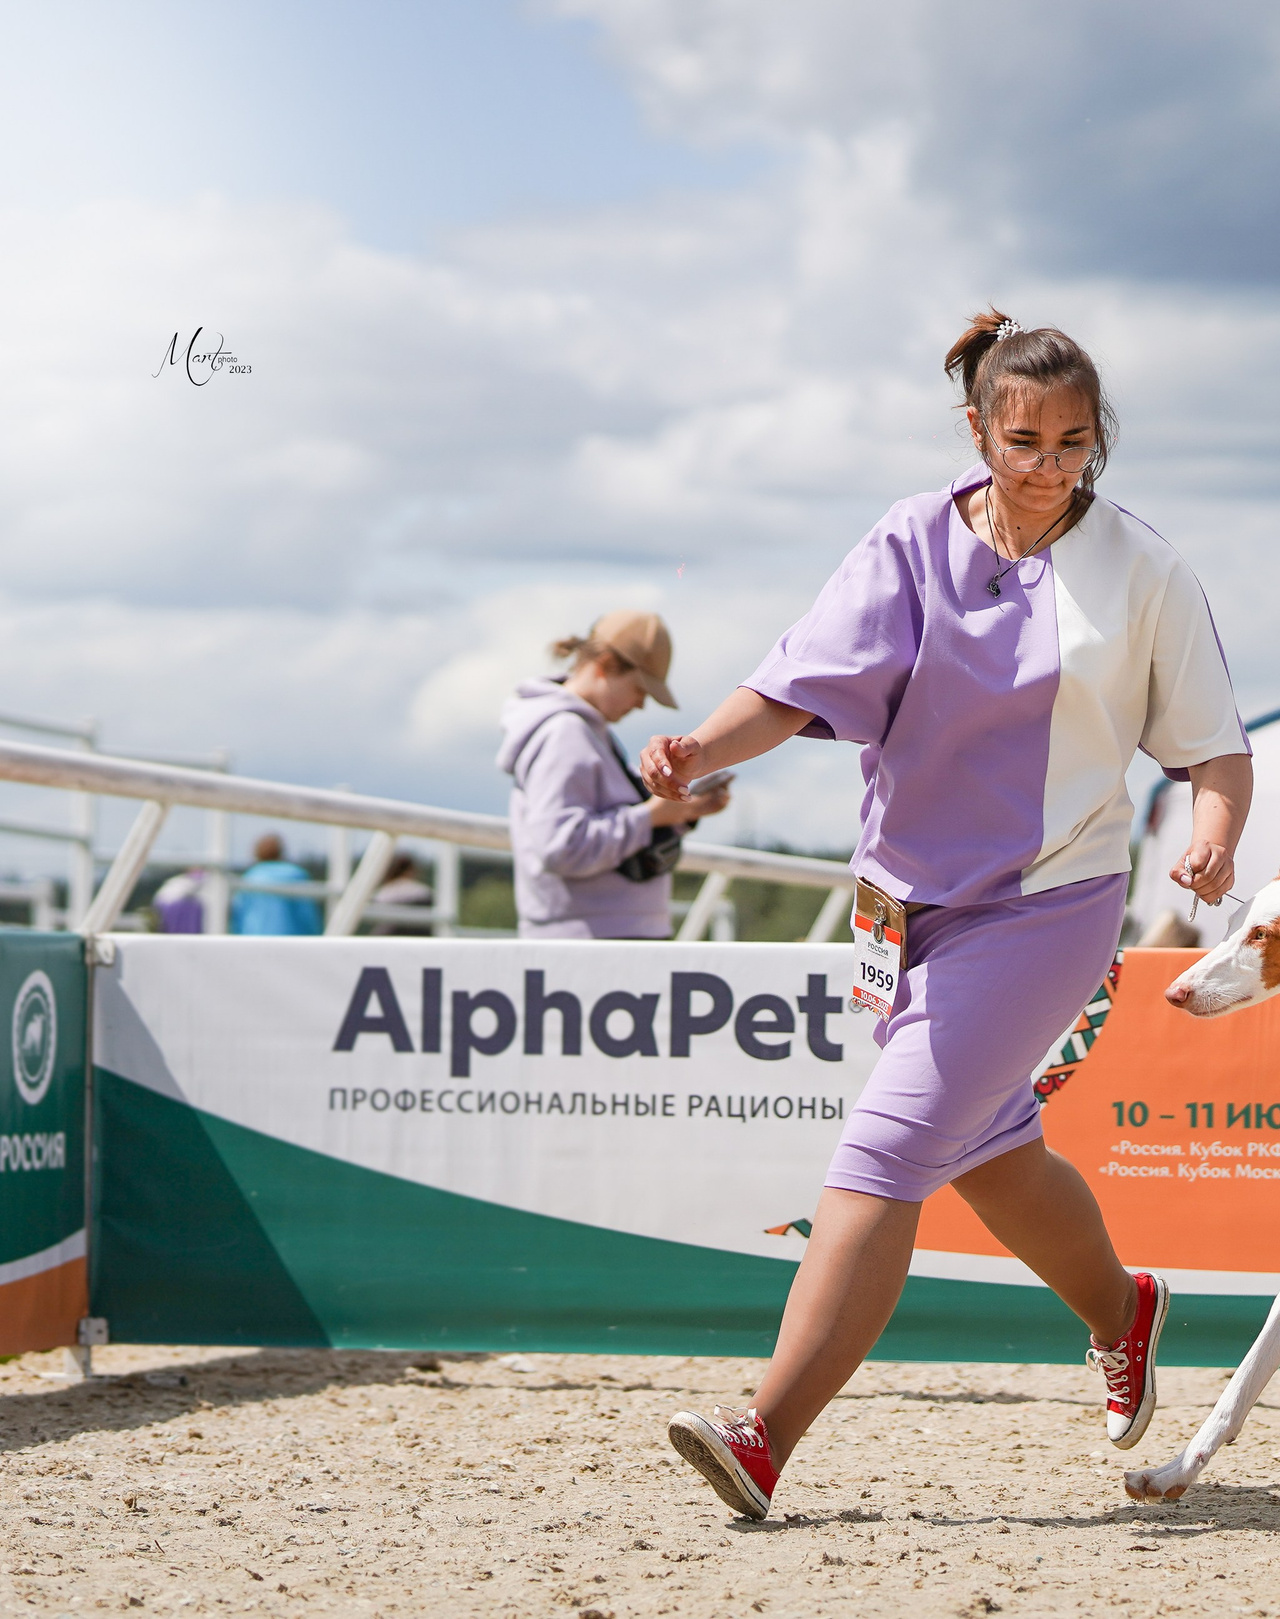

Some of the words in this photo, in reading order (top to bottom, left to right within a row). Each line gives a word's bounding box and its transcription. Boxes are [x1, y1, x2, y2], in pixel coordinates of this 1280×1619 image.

[867, 942, 889, 956] РОССИЯ
[860, 961, 894, 992] 1959
[332, 966, 844, 1077] AlphaPet
[329, 1088, 676, 1117] ПРОФЕССИОНАЛЬНЫЕ
[688, 1095, 844, 1122] РАЦИОНЫ
[1112, 1101, 1149, 1128] 10
[1185, 1102, 1214, 1128] 11
[0, 1131, 65, 1173] РОССИЯ
[1190, 1141, 1242, 1161] Кубок
[1178, 1162, 1231, 1182] Кубок
